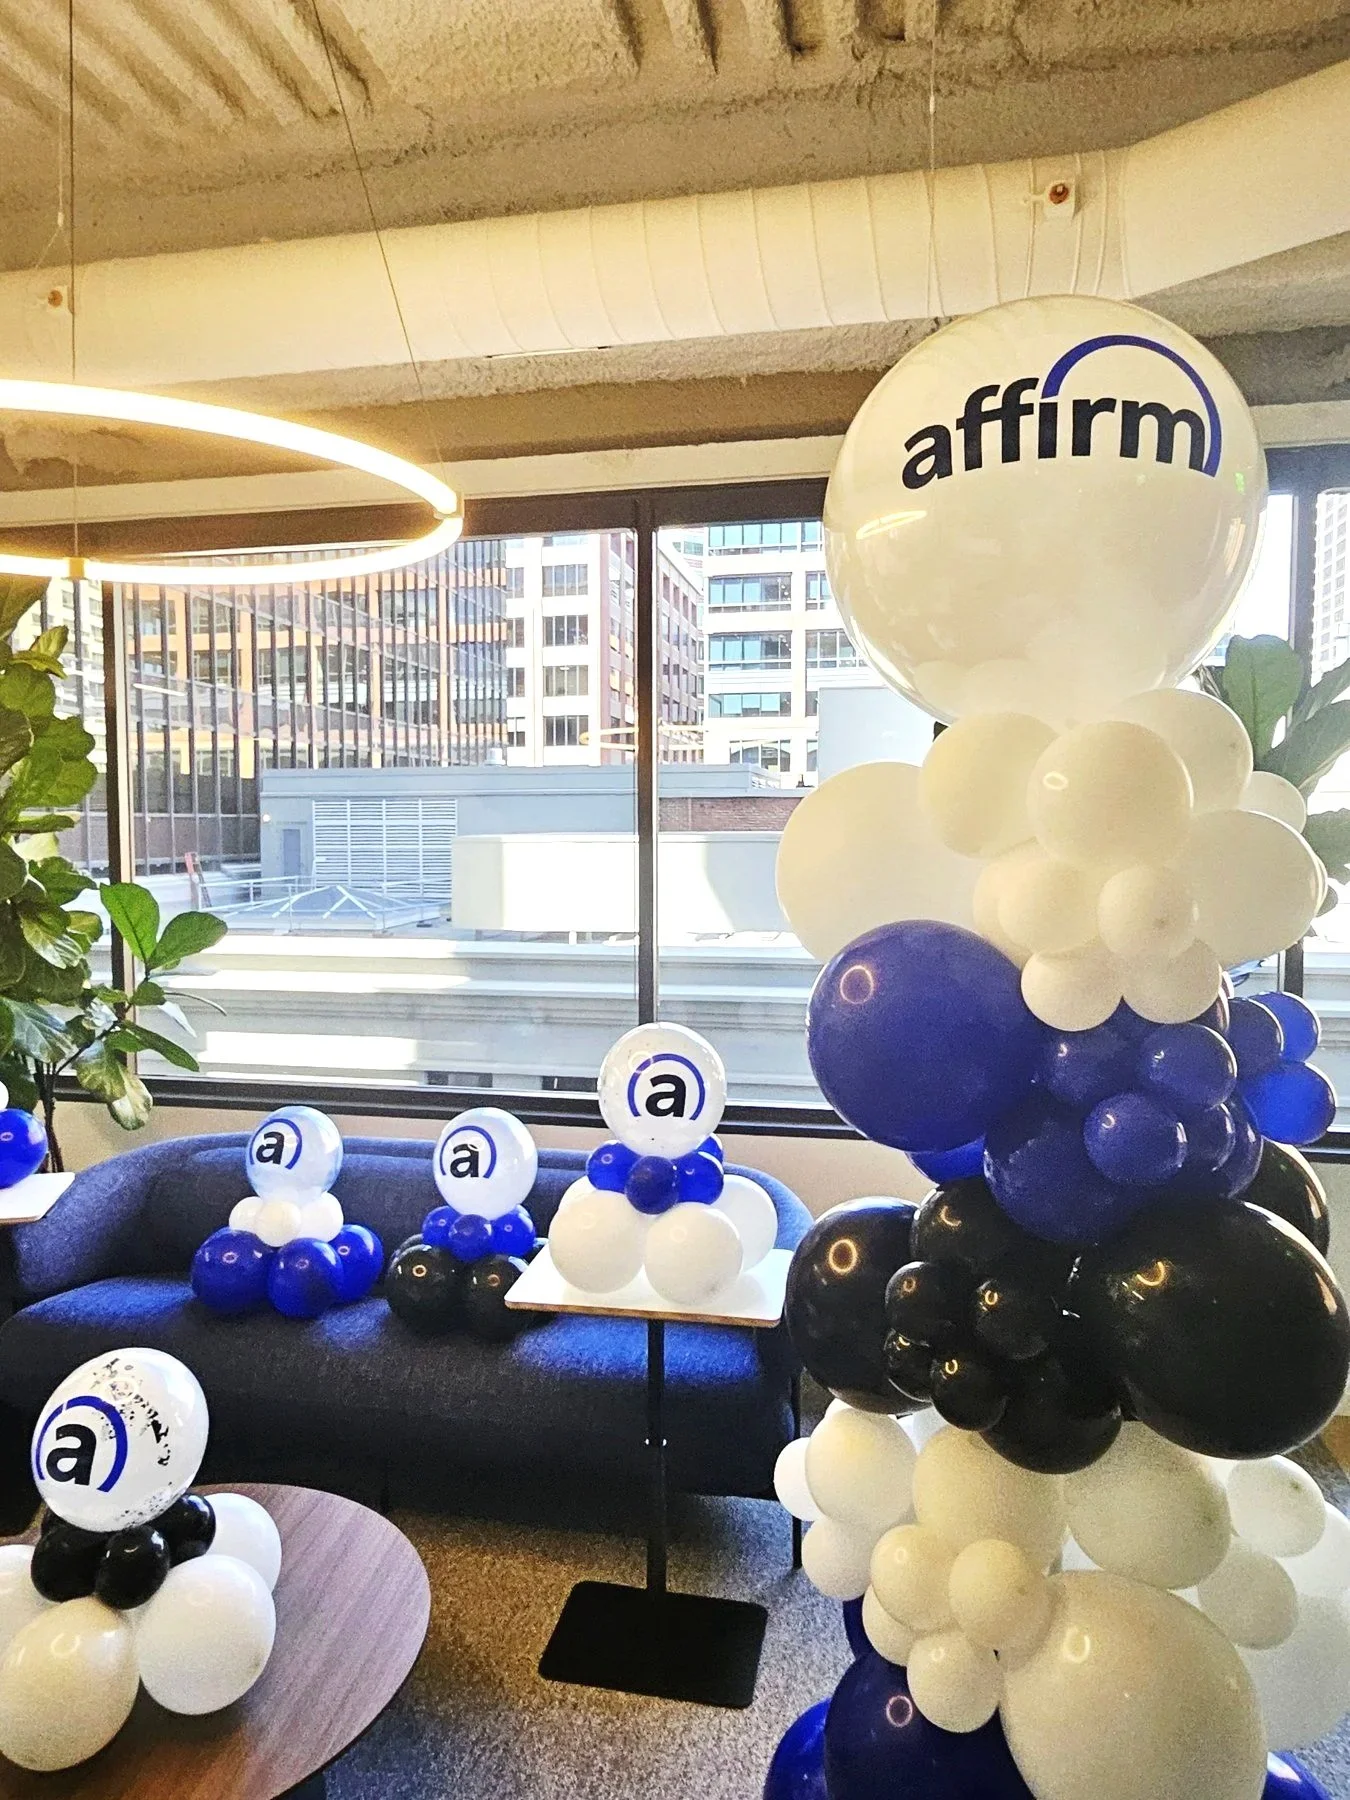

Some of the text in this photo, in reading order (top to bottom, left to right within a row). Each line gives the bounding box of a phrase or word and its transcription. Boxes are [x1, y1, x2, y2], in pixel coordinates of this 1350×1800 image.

[902, 377, 1207, 490] affirm
[646, 1073, 687, 1118] a
[256, 1131, 285, 1165] a
[450, 1143, 480, 1179] a
[45, 1423, 97, 1486] a
